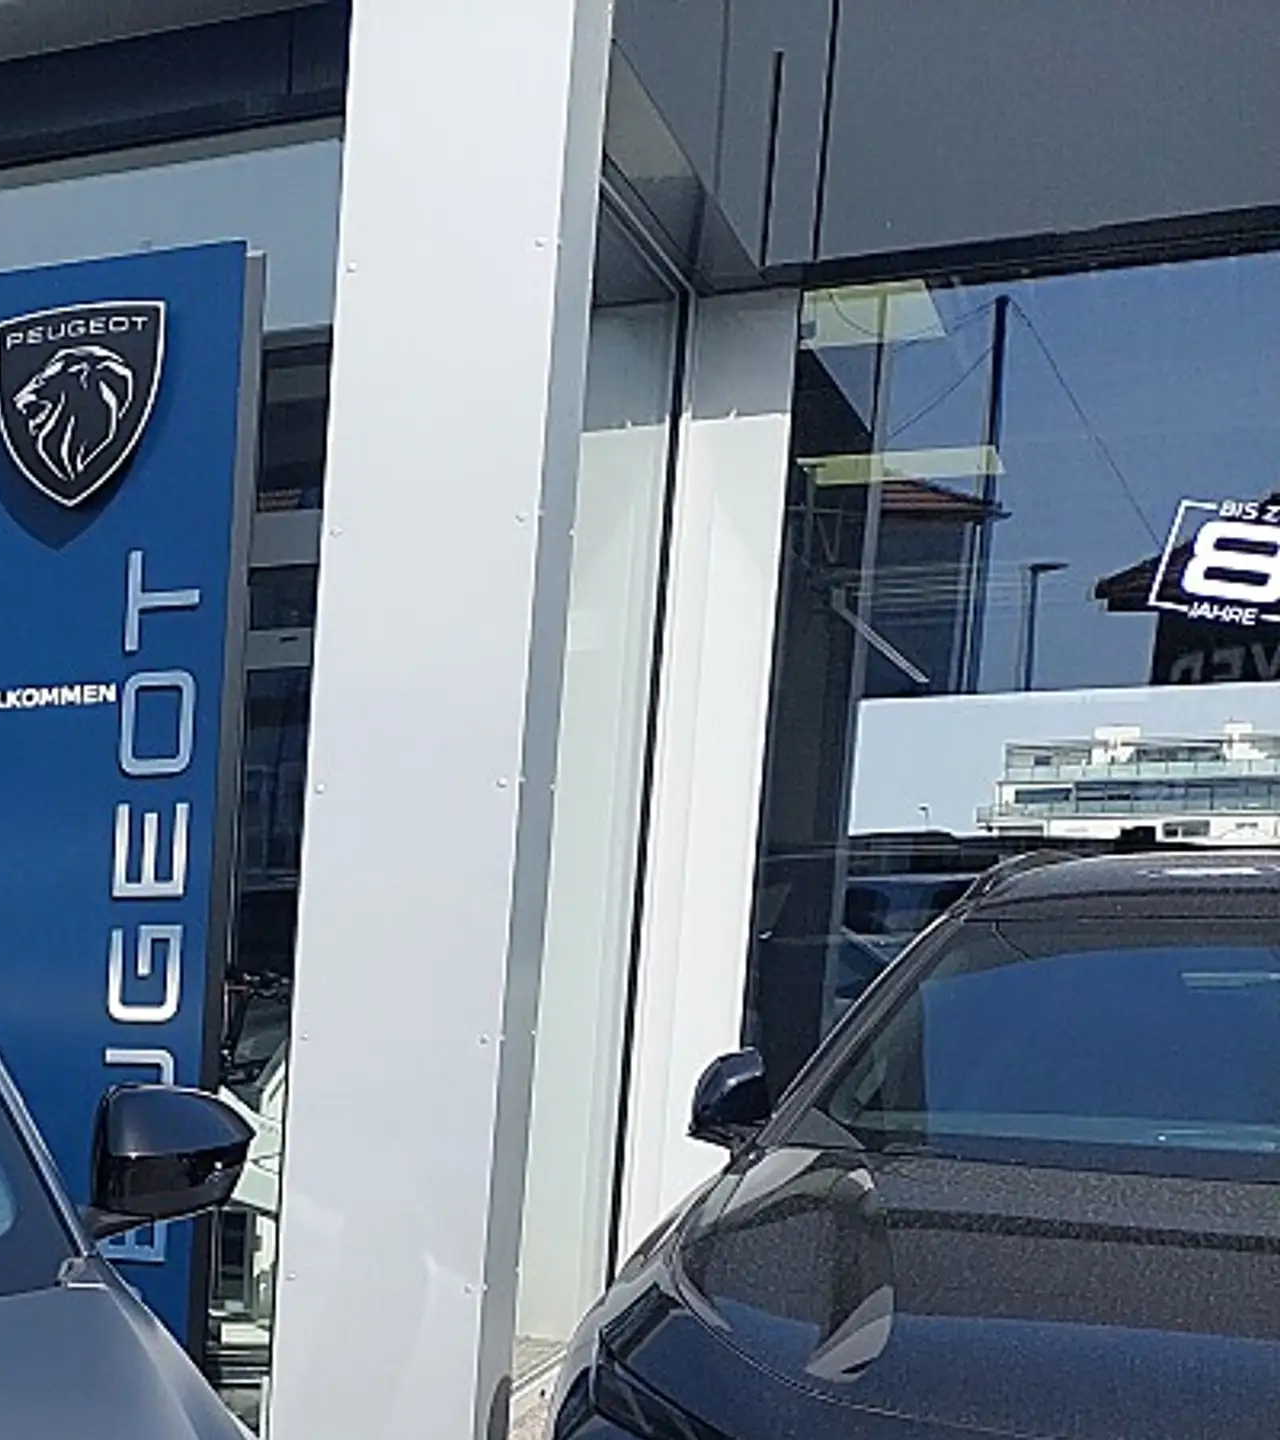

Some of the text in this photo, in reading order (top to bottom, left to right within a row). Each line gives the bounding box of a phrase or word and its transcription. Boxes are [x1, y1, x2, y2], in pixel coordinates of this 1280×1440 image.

[6, 315, 148, 350] PEUGEOT
[1219, 500, 1259, 519] BIS
[1181, 520, 1280, 603] 8
[1187, 602, 1259, 626] JAHRE
